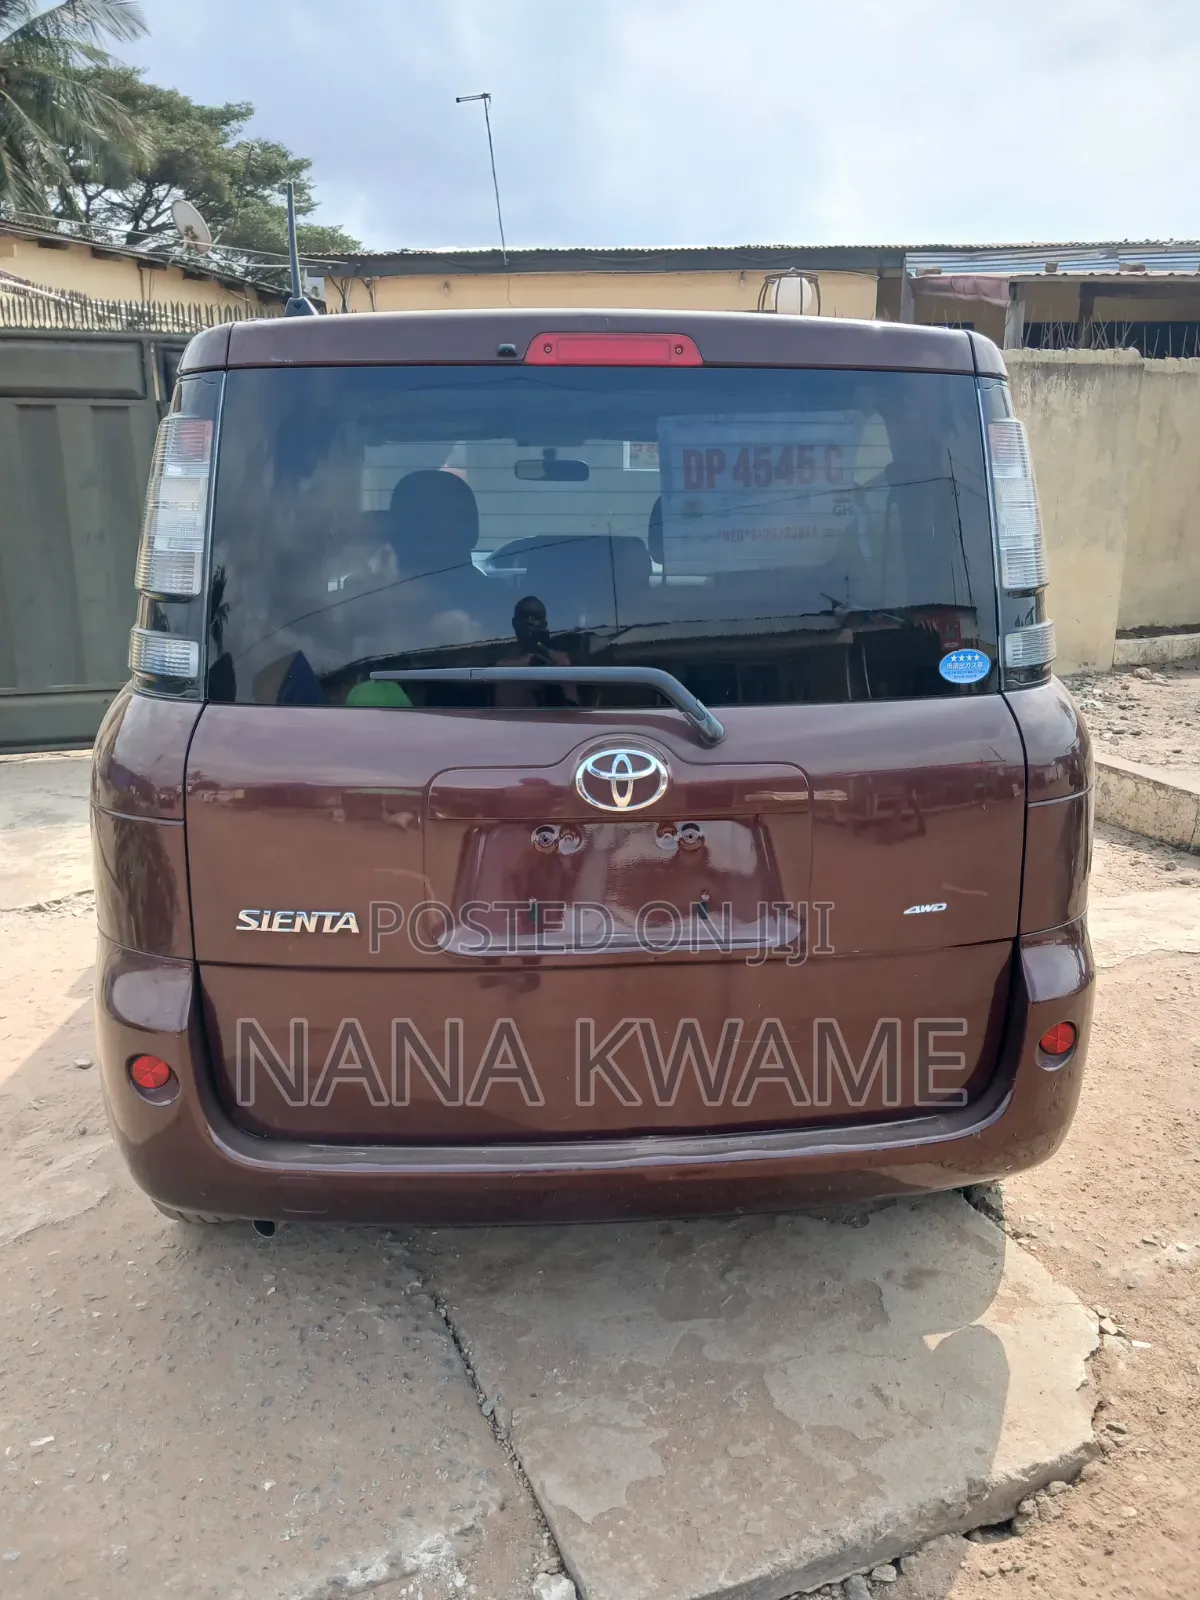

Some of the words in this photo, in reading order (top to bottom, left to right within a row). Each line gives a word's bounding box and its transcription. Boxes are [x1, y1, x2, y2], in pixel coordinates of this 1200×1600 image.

[682, 448, 726, 491] DP
[732, 444, 816, 488] 4545
[903, 902, 948, 915] 4WD
[235, 909, 360, 934] SIENTA
